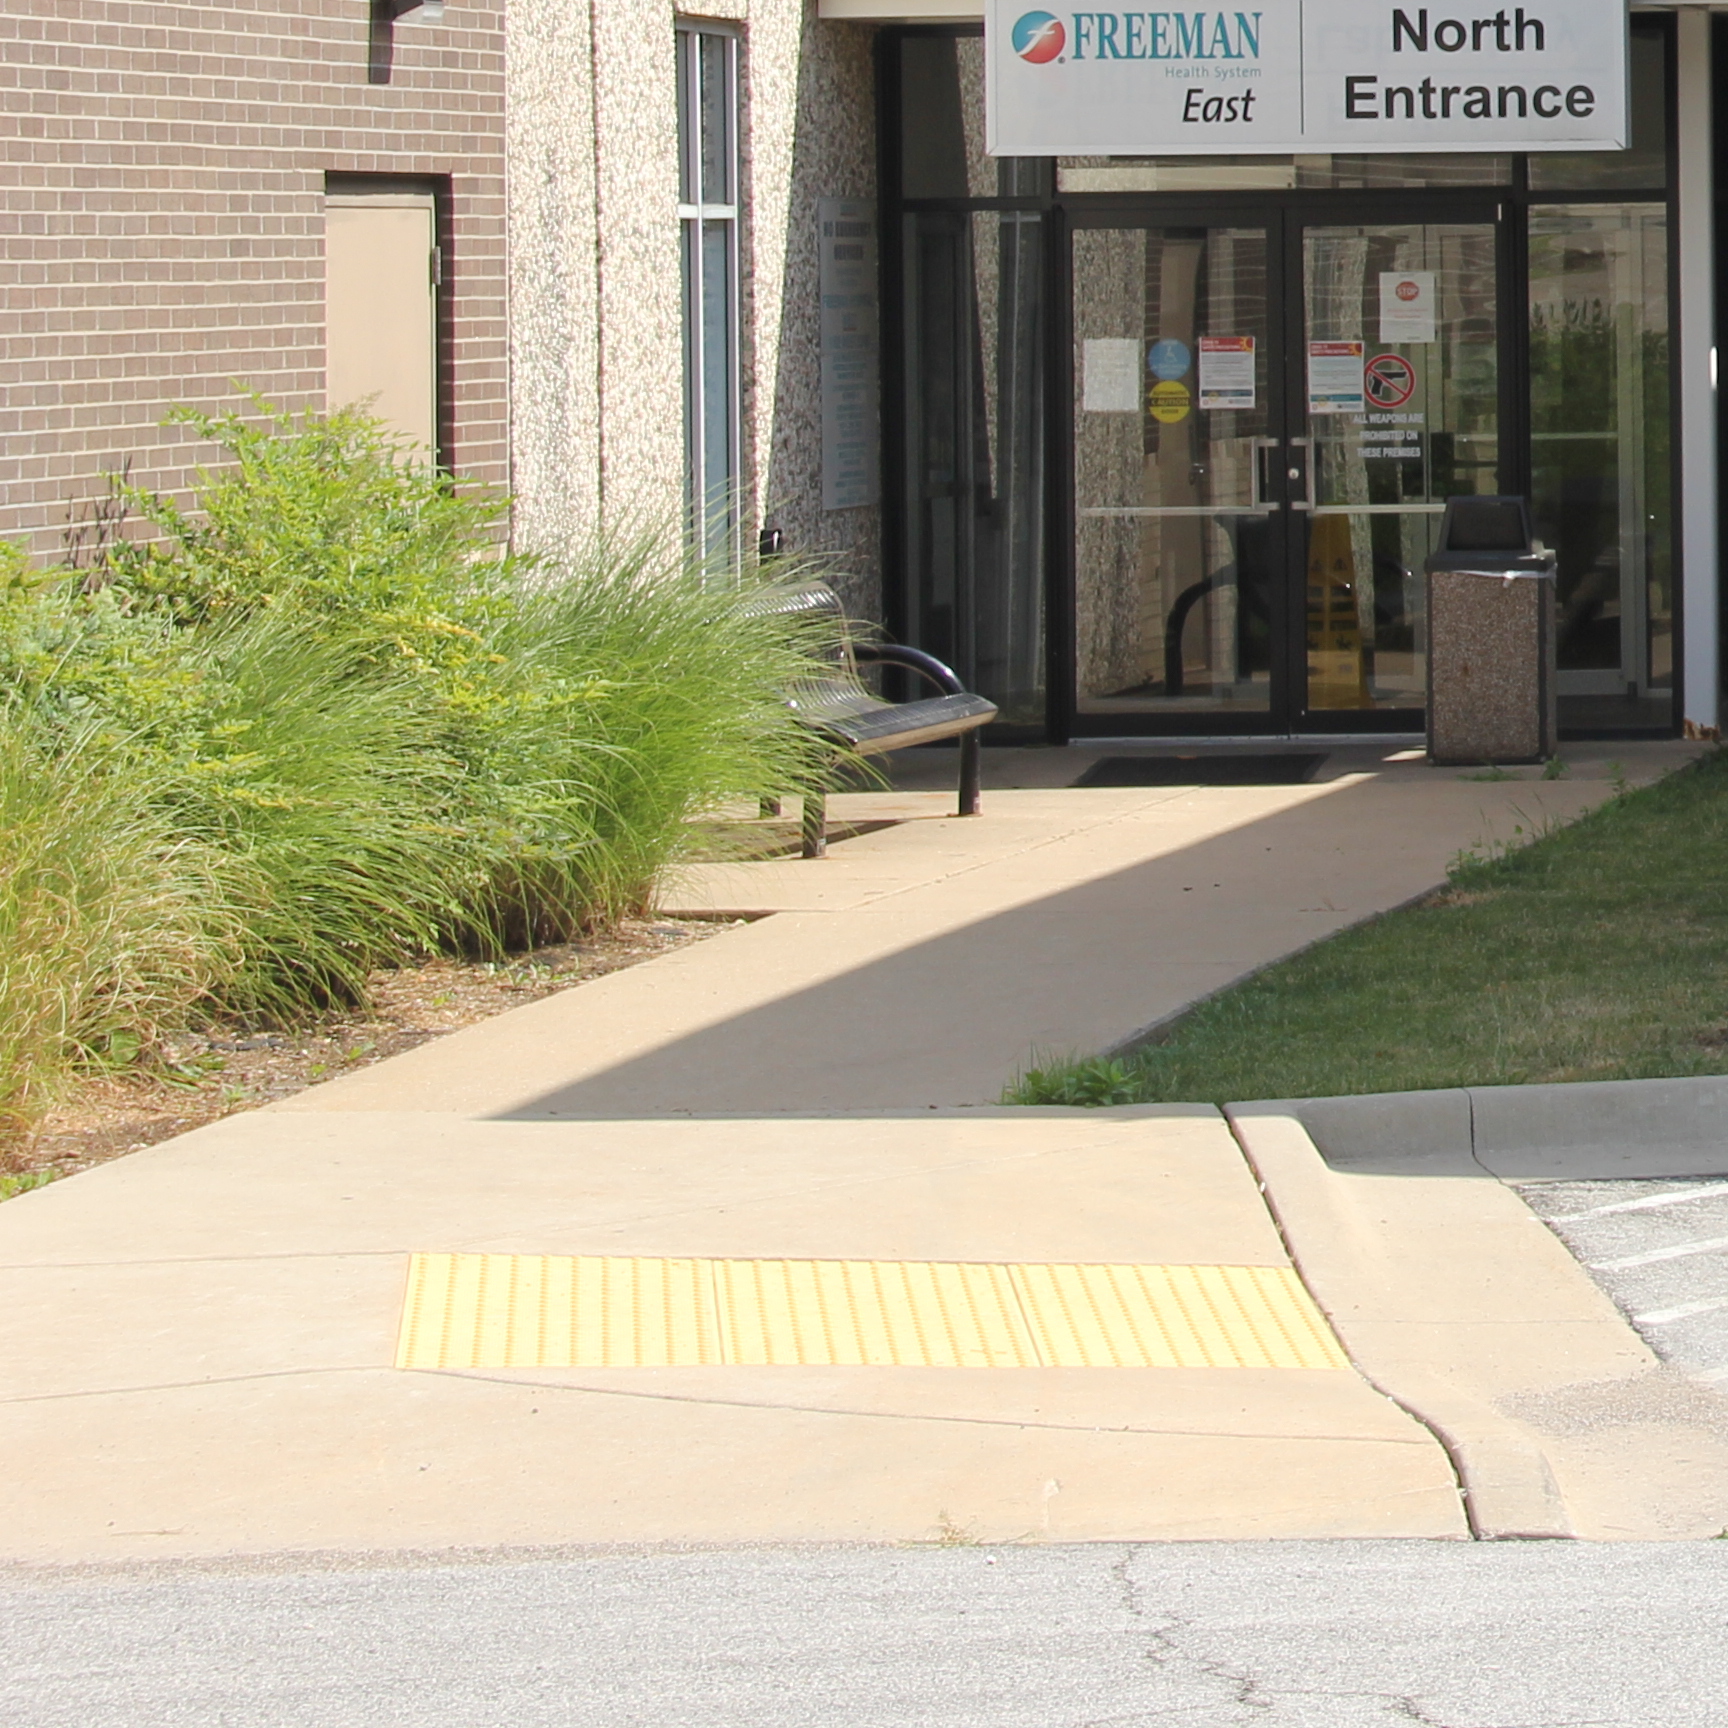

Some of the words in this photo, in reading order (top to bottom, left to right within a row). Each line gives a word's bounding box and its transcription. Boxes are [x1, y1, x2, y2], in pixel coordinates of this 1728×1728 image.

[1071, 10, 1263, 61] FREEMAN
[1391, 7, 1545, 53] North
[1164, 65, 1210, 80] Health
[1214, 65, 1262, 81] System
[1344, 75, 1596, 120] Entrance
[1182, 87, 1256, 125] East
[1396, 286, 1419, 296] STOP
[1353, 413, 1368, 424] ALL
[1369, 413, 1407, 424] WEAPONS
[1408, 413, 1424, 423] ARE
[1360, 430, 1405, 441] PROHIBITED
[1406, 430, 1418, 441] ON
[1357, 447, 1381, 458] THESE
[1383, 447, 1421, 458] PREMISES
